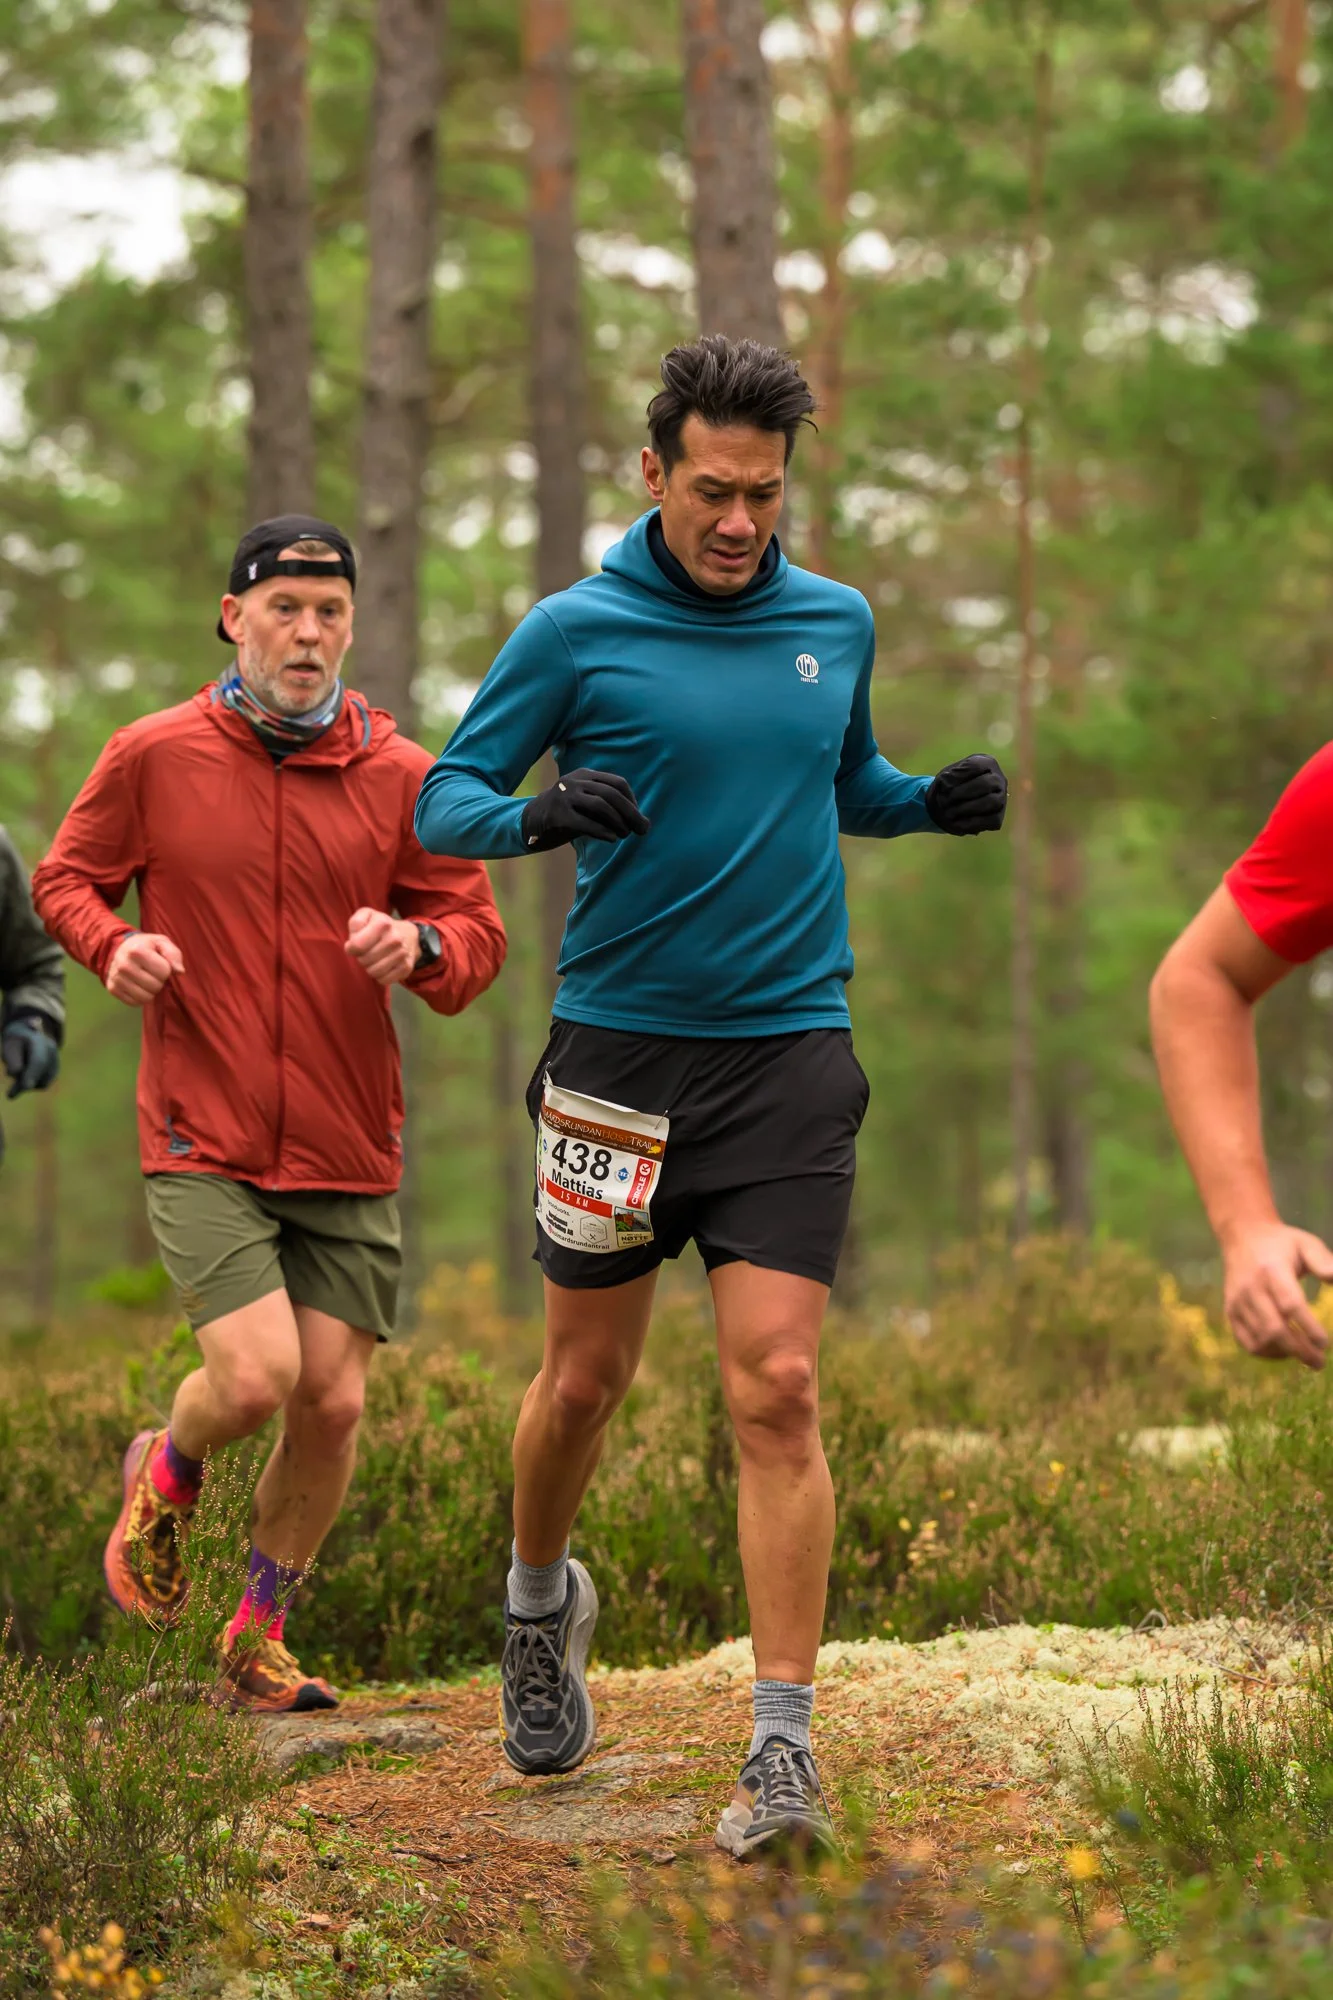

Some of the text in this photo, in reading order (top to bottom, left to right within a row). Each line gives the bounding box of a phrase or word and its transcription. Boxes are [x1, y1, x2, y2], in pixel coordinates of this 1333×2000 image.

[551, 1137, 612, 1181] 438
[551, 1168, 604, 1200] Mattias
[560, 1190, 571, 1202] 15
[575, 1196, 589, 1208] KM
[631, 1163, 651, 1205] CIRCLE K
